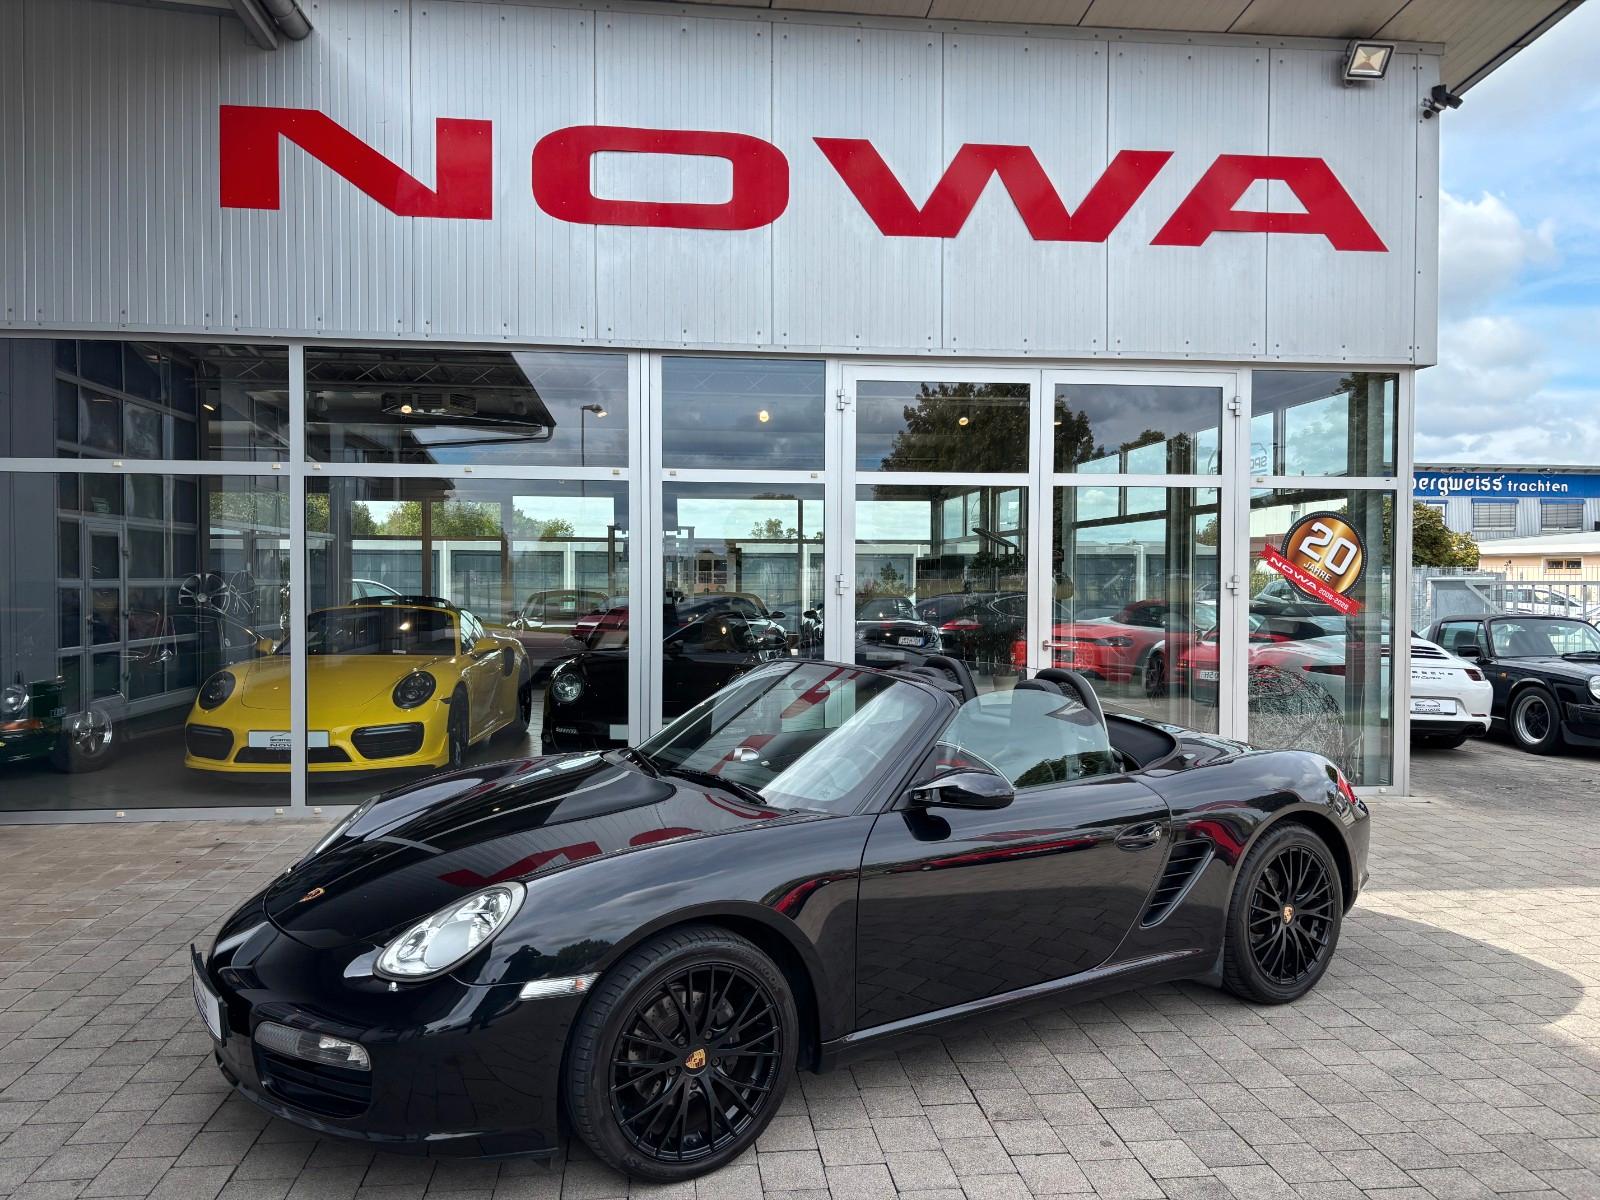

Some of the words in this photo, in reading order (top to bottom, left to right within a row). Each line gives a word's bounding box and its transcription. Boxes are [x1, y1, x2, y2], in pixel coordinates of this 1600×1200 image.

[220, 105, 1388, 251] NOWA
[1507, 480, 1568, 492] trachten
[1299, 522, 1357, 576] 20
[1270, 557, 1317, 590] NOWA
[1303, 561, 1332, 582] JAHRE
